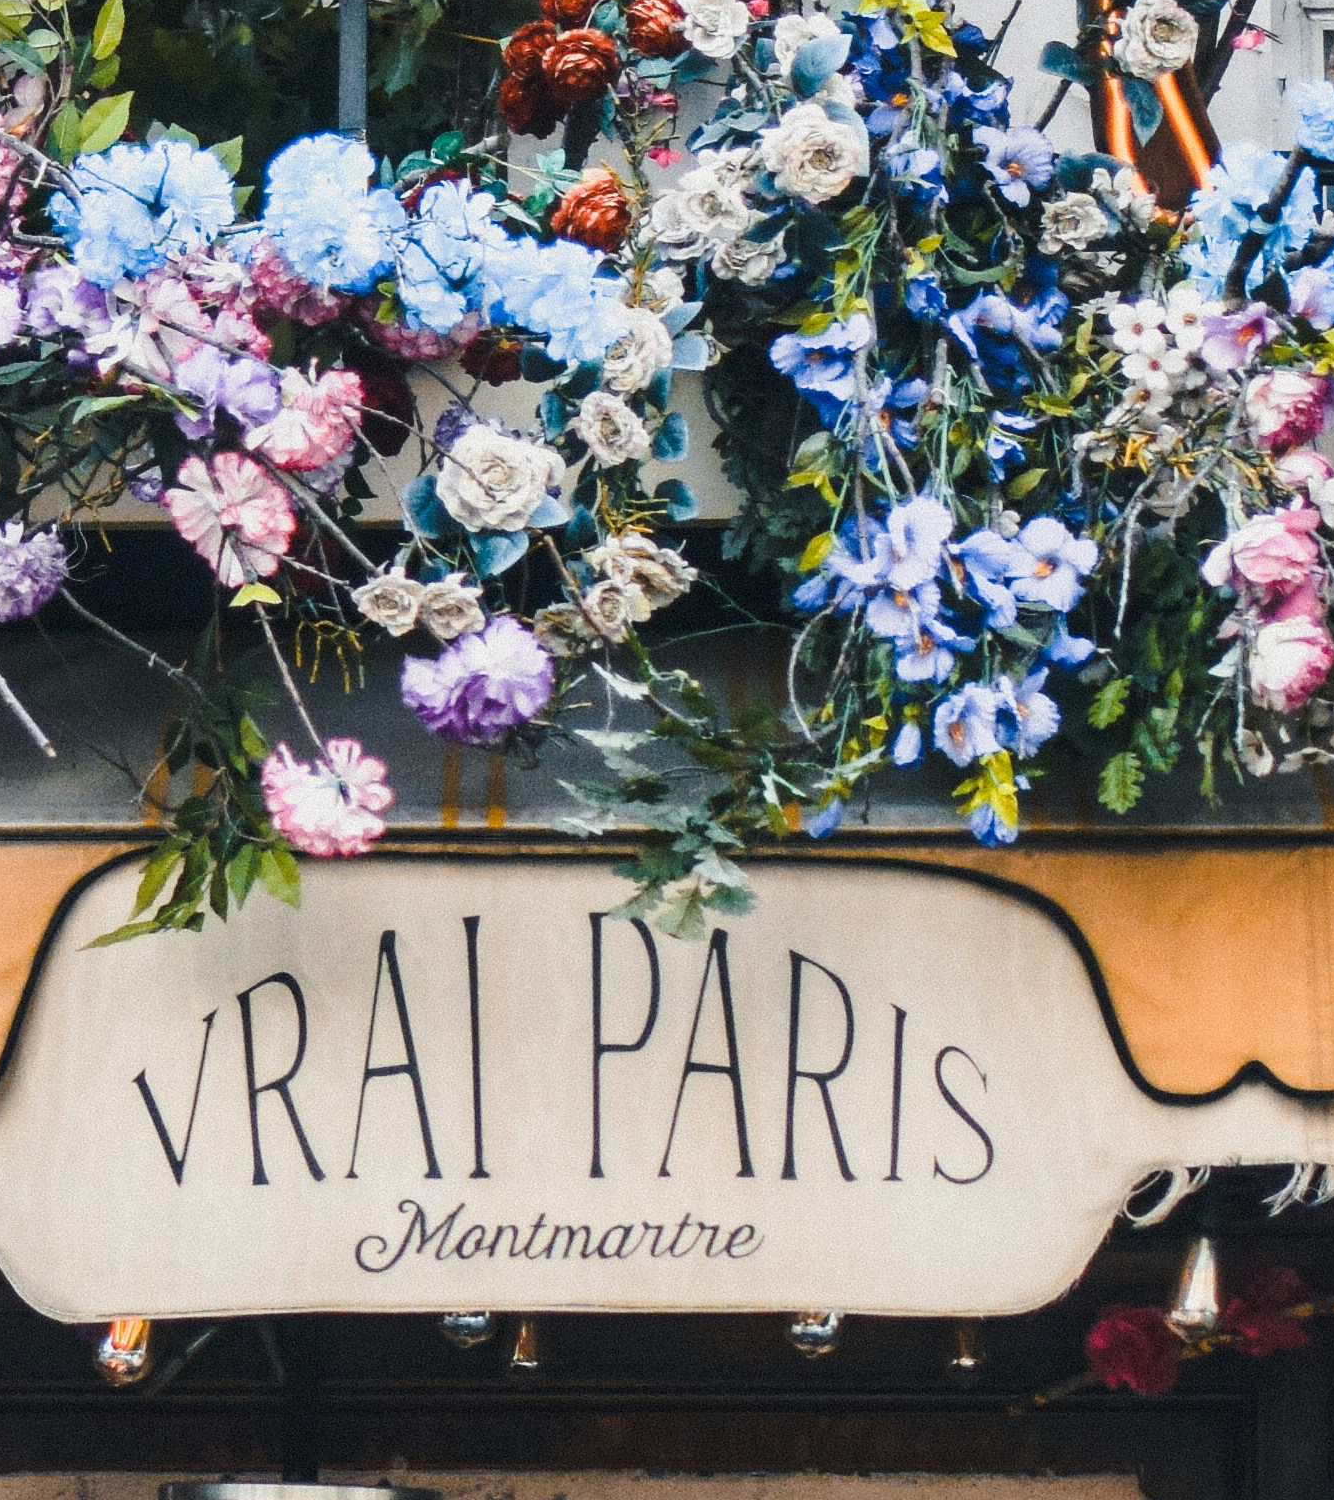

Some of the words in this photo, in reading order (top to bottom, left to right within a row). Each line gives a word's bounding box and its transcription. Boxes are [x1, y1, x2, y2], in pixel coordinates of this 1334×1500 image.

[131, 913, 490, 1187] VRAI
[589, 911, 996, 1185] PARIS
[355, 1198, 765, 1274] Montmartre
